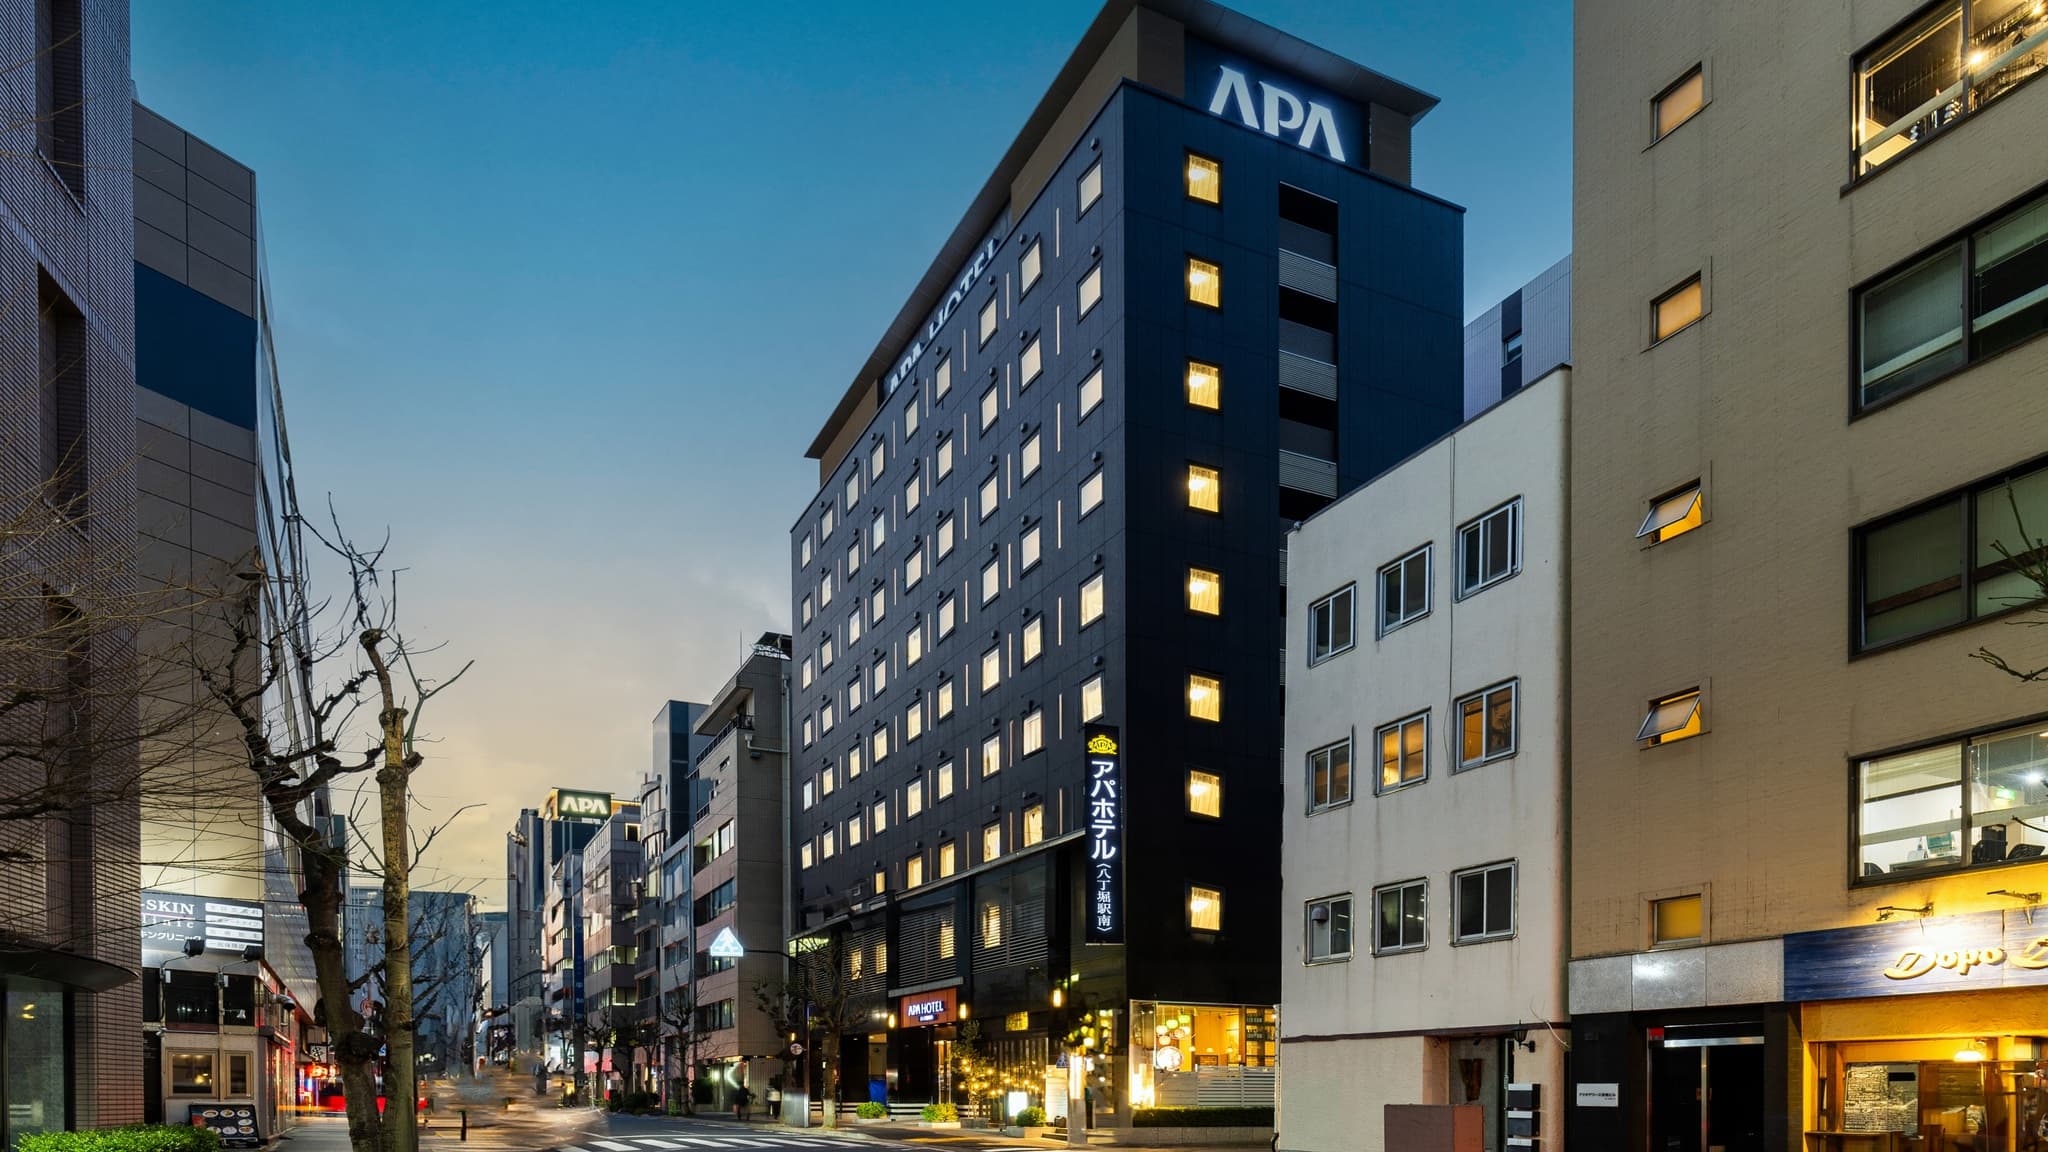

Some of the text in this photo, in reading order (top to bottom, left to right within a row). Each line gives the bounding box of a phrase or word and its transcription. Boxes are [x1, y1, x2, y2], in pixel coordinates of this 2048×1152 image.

[1209, 65, 1346, 162] APA
[560, 796, 608, 815] APA
[1090, 760, 1117, 860] アパホテル
[1883, 948, 2005, 980] Dopo
[908, 1000, 944, 1017] APA HOTEL
